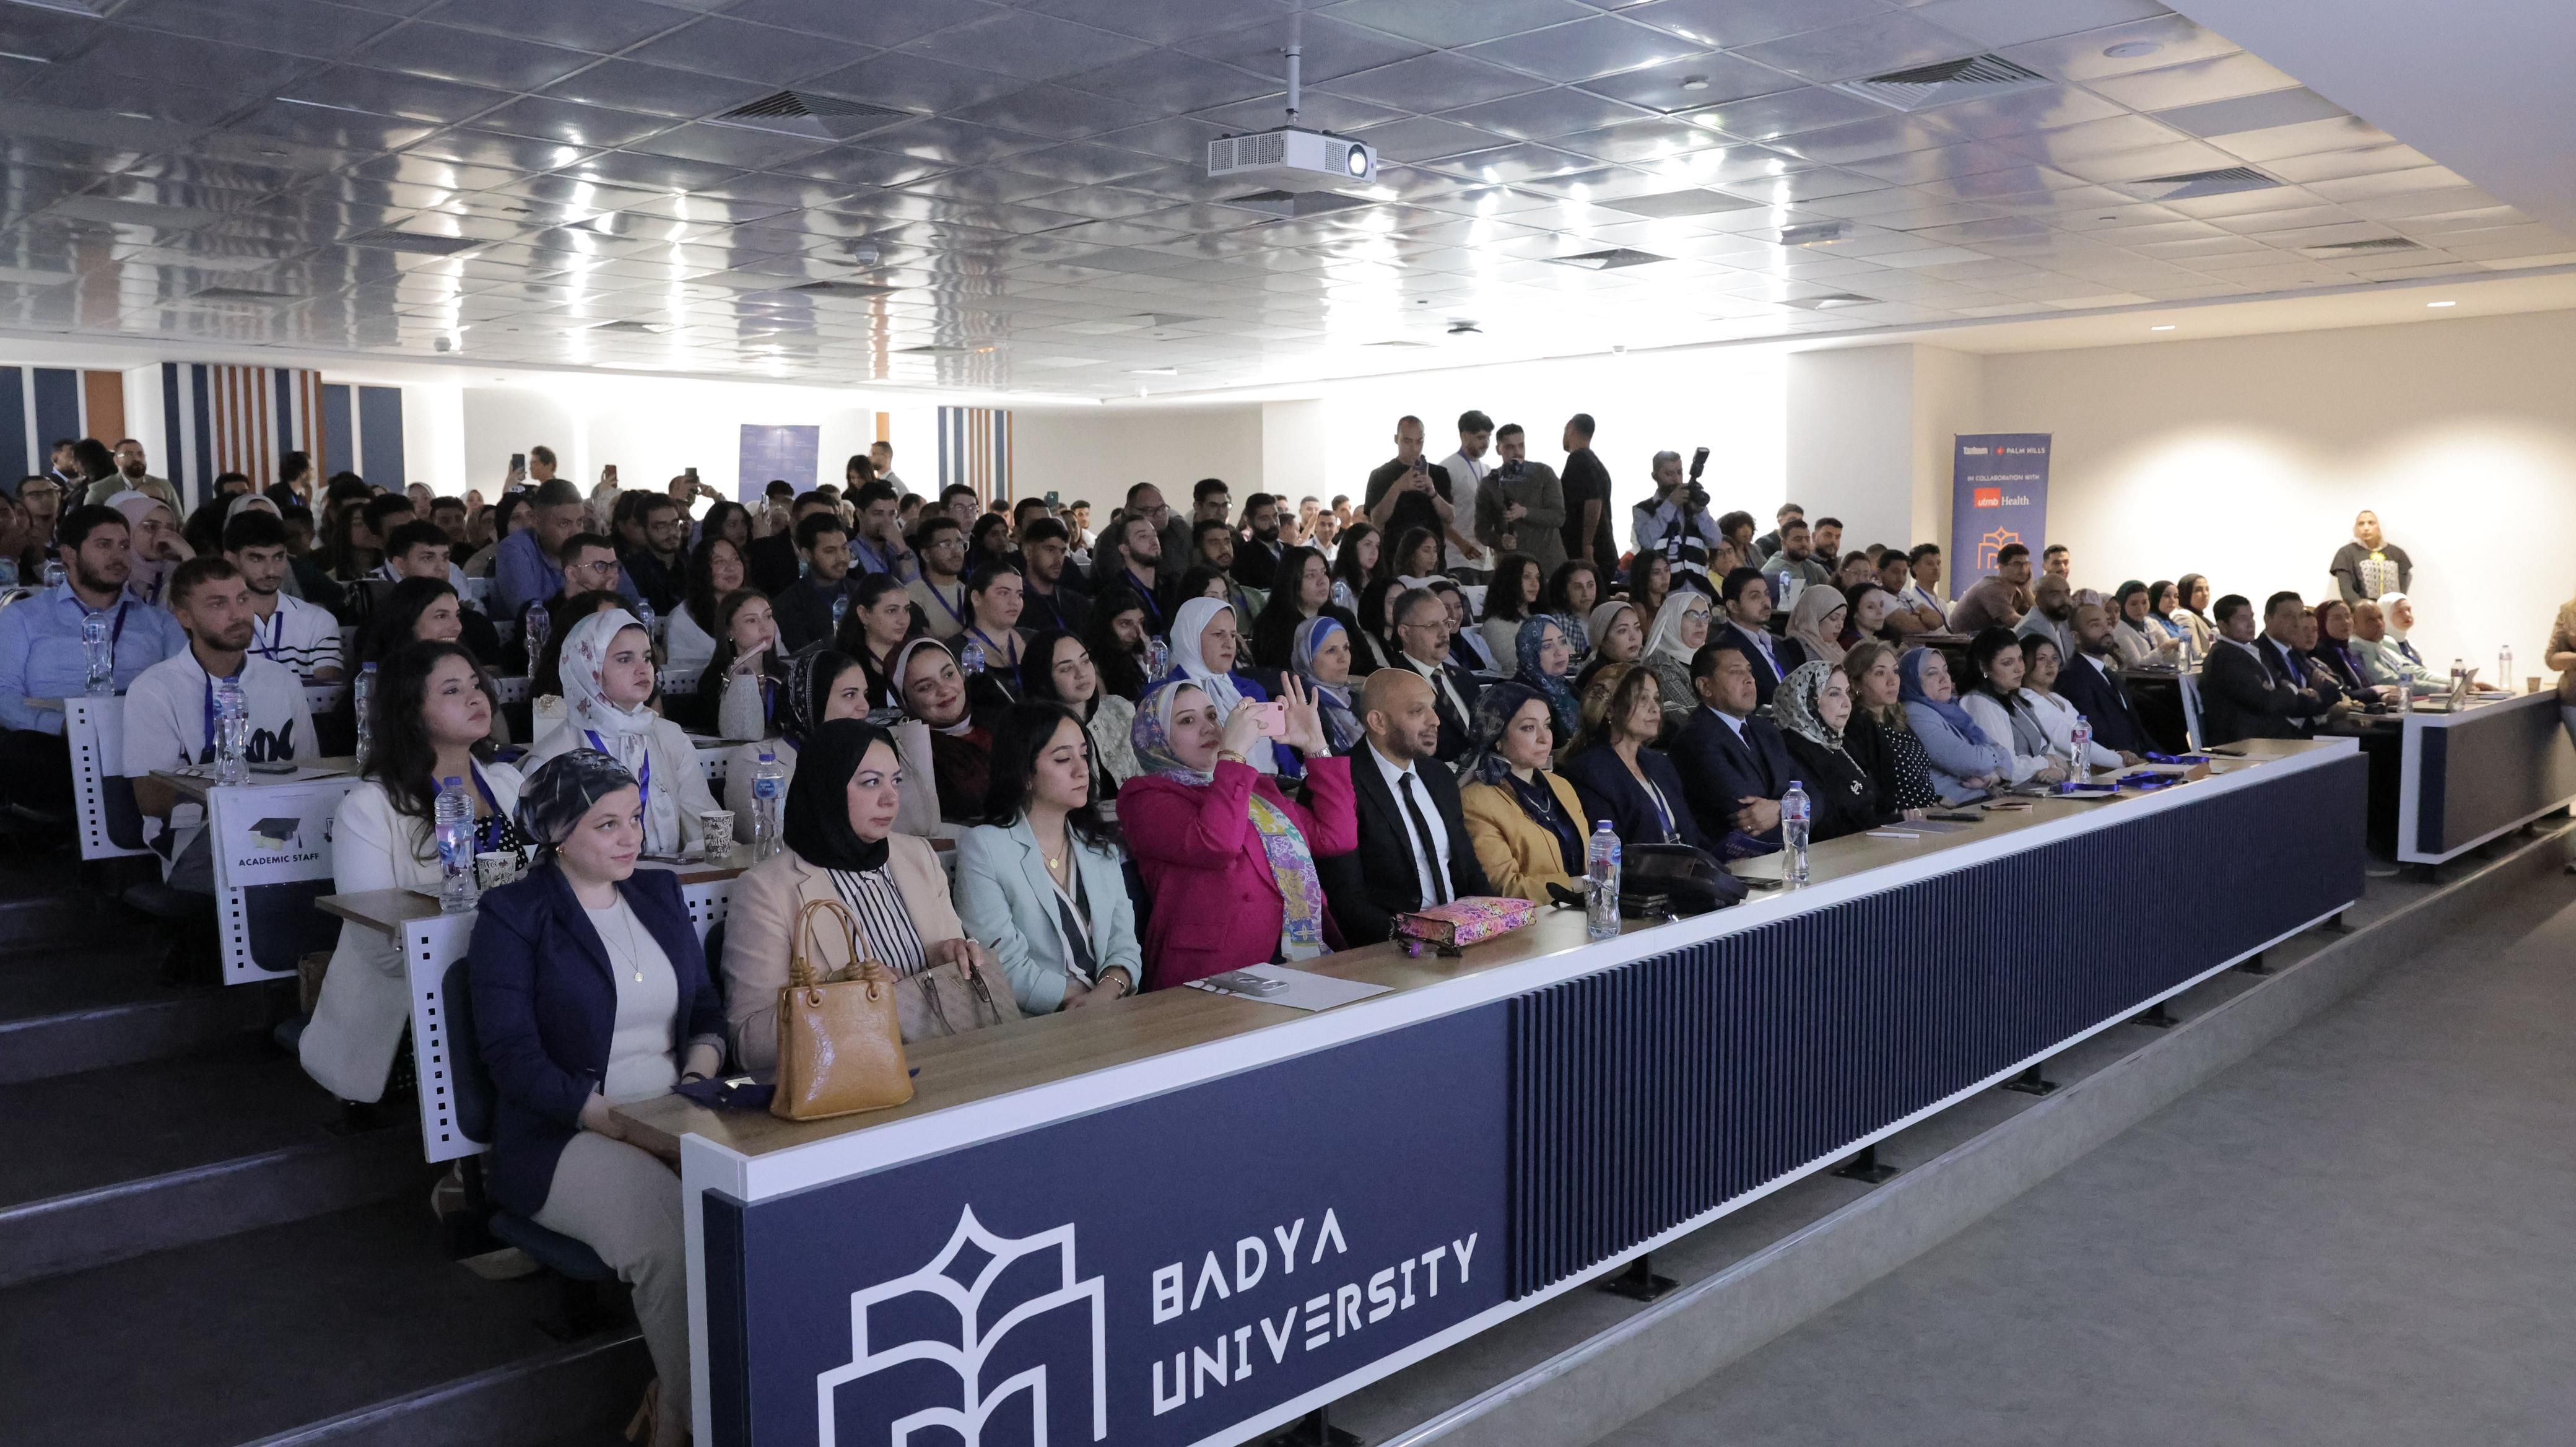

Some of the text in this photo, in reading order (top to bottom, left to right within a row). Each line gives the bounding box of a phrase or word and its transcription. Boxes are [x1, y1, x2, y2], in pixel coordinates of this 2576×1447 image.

[1977, 496, 2029, 506] utmb Health
[238, 852, 320, 867] ACADEMIC STAFF
[1153, 1207, 1347, 1325] BADYA
[1153, 1232, 1478, 1417] UNIVERSITY
